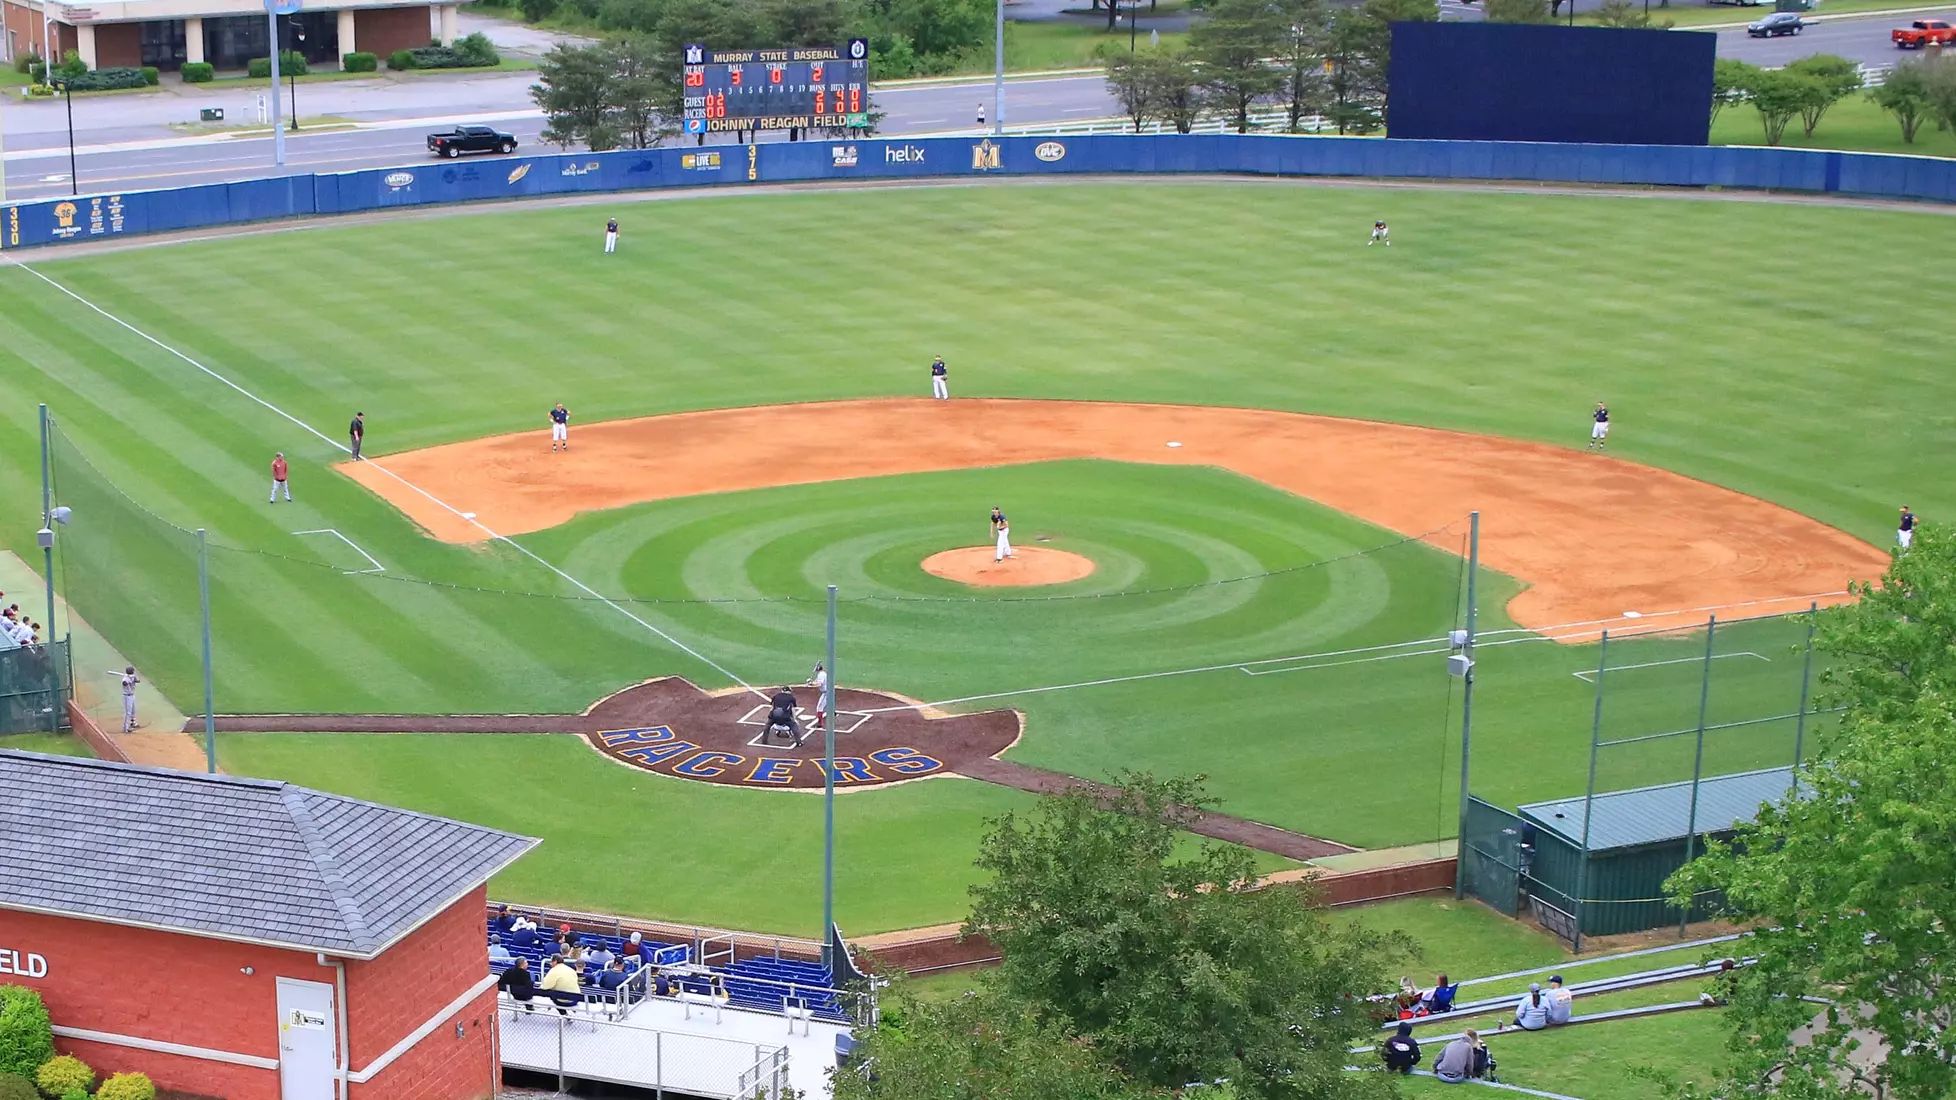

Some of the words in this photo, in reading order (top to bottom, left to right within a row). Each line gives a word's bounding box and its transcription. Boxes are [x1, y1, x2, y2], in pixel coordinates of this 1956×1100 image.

[713, 52, 753, 63] MURRAY
[760, 51, 787, 61] STATE
[793, 50, 839, 60] BASEBALL
[728, 64, 743, 72] BALL
[766, 63, 787, 71] STRIKE
[811, 61, 824, 69] OUT
[687, 72, 704, 86] 20
[732, 70, 742, 85] 3
[772, 68, 782, 83] 0
[812, 68, 823, 82] 2
[728, 86, 732, 95] 3
[749, 86, 753, 94] 5
[769, 86, 773, 95] 7
[809, 84, 825, 92] RUNS
[830, 83, 845, 91] HITS
[849, 83, 861, 91] ERR
[706, 94, 714, 106] 0
[717, 94, 724, 106] 2
[816, 90, 824, 102] 2
[837, 90, 845, 101] 4
[851, 89, 860, 100] 0
[684, 97, 705, 108] GUEST
[816, 102, 824, 113] 0
[836, 101, 845, 113] 0
[851, 101, 859, 112] 0
[684, 108, 706, 119] RACERS
[706, 107, 714, 118] 0
[717, 106, 724, 117] 0
[706, 118, 755, 131] JOHNNY
[760, 116, 808, 129] REAGAN
[813, 115, 847, 127] FIELD
[885, 144, 925, 162] helix
[696, 155, 709, 166] LIVE
[748, 145, 756, 180] 375
[61, 209, 71, 218] 36
[10, 207, 19, 245] 330
[597, 724, 943, 784] RACERS
[0, 948, 48, 978] ELD
